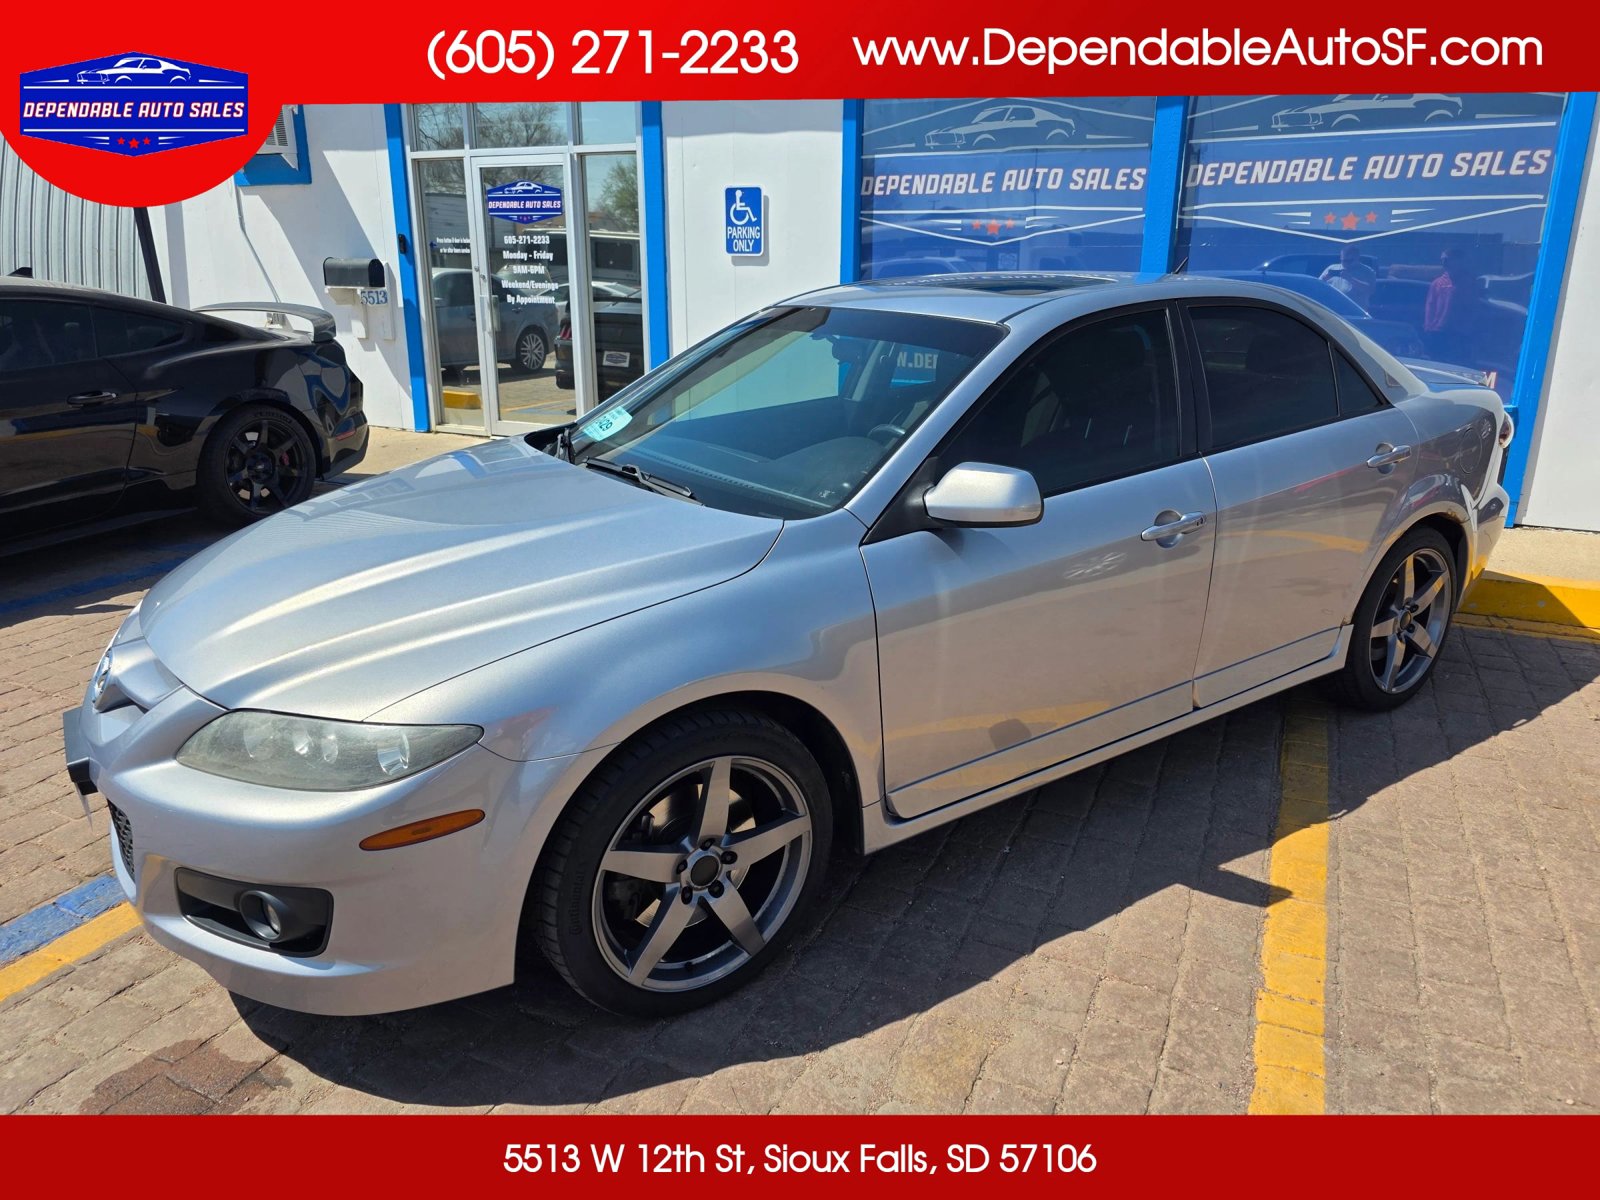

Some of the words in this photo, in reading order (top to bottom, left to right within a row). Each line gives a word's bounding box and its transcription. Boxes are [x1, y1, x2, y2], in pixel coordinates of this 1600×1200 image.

[1185, 156, 1358, 188] DEPENDABLE
[1363, 152, 1444, 181] AUTO
[1450, 149, 1552, 177] SALES
[860, 172, 996, 196] DEPENDABLE
[1001, 168, 1064, 192] AUTO
[1069, 167, 1147, 191] SALES
[488, 201, 524, 209] DEPENDABLE
[525, 200, 541, 209] AUTO
[542, 200, 561, 209] SALES
[727, 226, 761, 239] PARKING
[503, 235, 550, 245] 605-271-2233
[732, 239, 755, 252] ONLY
[502, 250, 528, 261] Monday
[533, 250, 554, 261] Friday
[501, 280, 559, 291] Weekend/Evenings
[360, 290, 388, 305] 5513
[506, 294, 515, 305] By
[516, 294, 556, 305] Appointment
